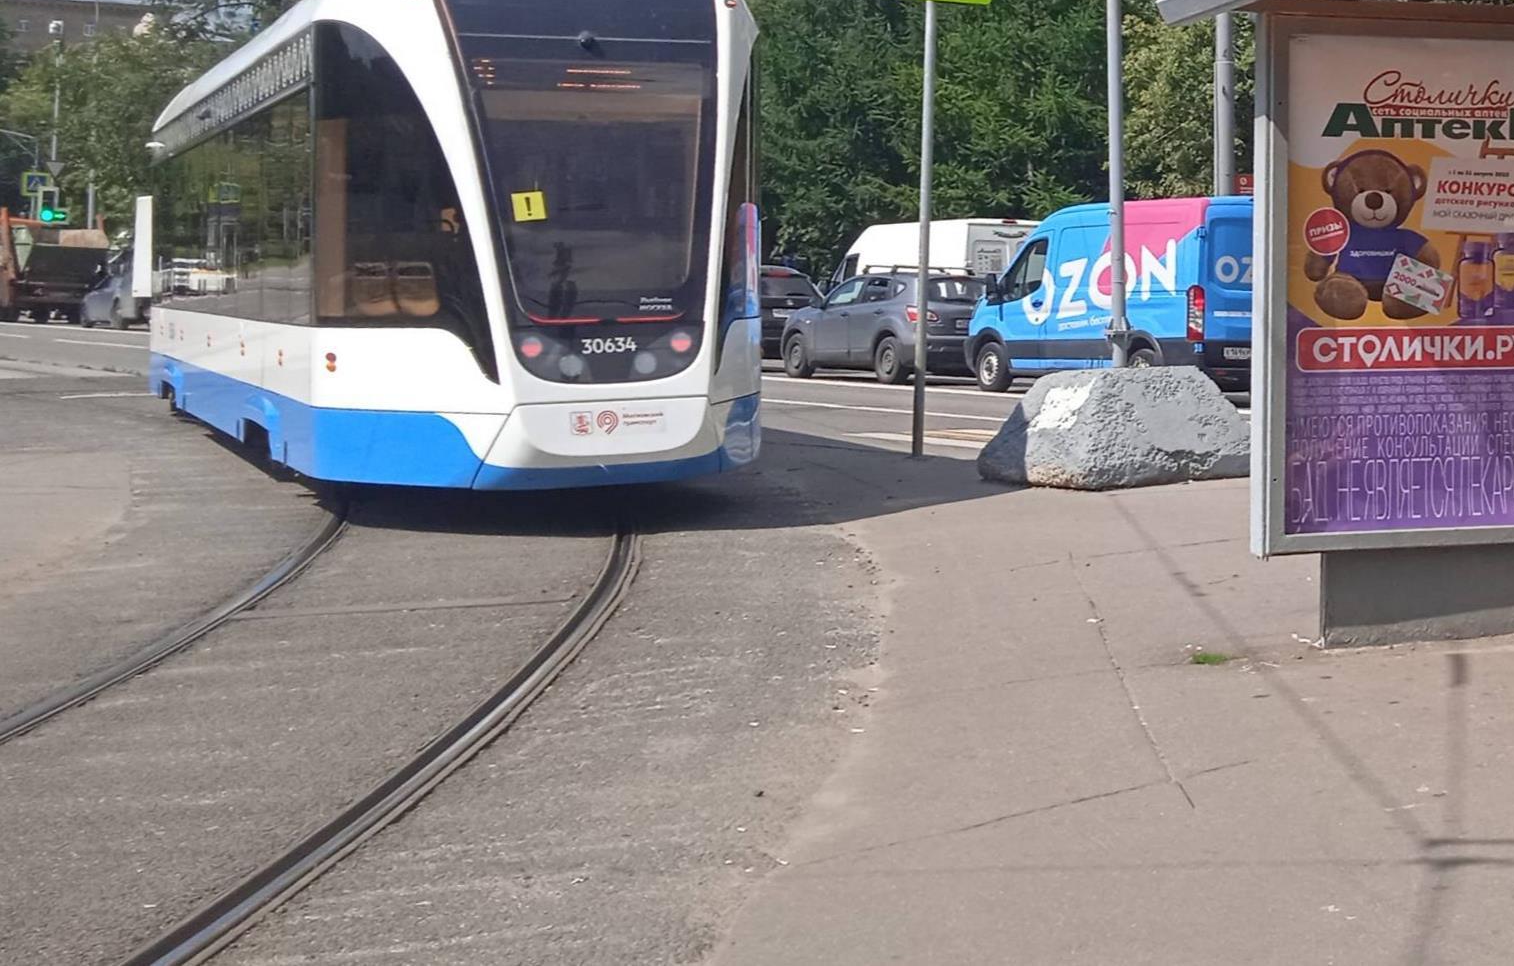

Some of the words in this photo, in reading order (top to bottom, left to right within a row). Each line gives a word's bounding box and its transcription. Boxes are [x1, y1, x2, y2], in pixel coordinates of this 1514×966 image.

[1372, 105, 1397, 117] сеть
[1399, 106, 1472, 120] социальных
[1474, 107, 1509, 119] аптек
[1434, 197, 1475, 206] детского
[1309, 221, 1343, 237] ПРИЗЫ
[1022, 238, 1178, 326] OZON
[1393, 271, 1417, 286] 2000
[581, 337, 638, 354] 30634
[1291, 415, 1354, 438] ИМЕЮТСЯ
[1291, 436, 1369, 461] ПОЛУЧЕНИЕ
[1377, 434, 1480, 459] КОНСУЛЬТАЦИИ
[1336, 459, 1361, 521] НЕ
[1363, 456, 1454, 521] ЯВЛЯЕТСЯ
